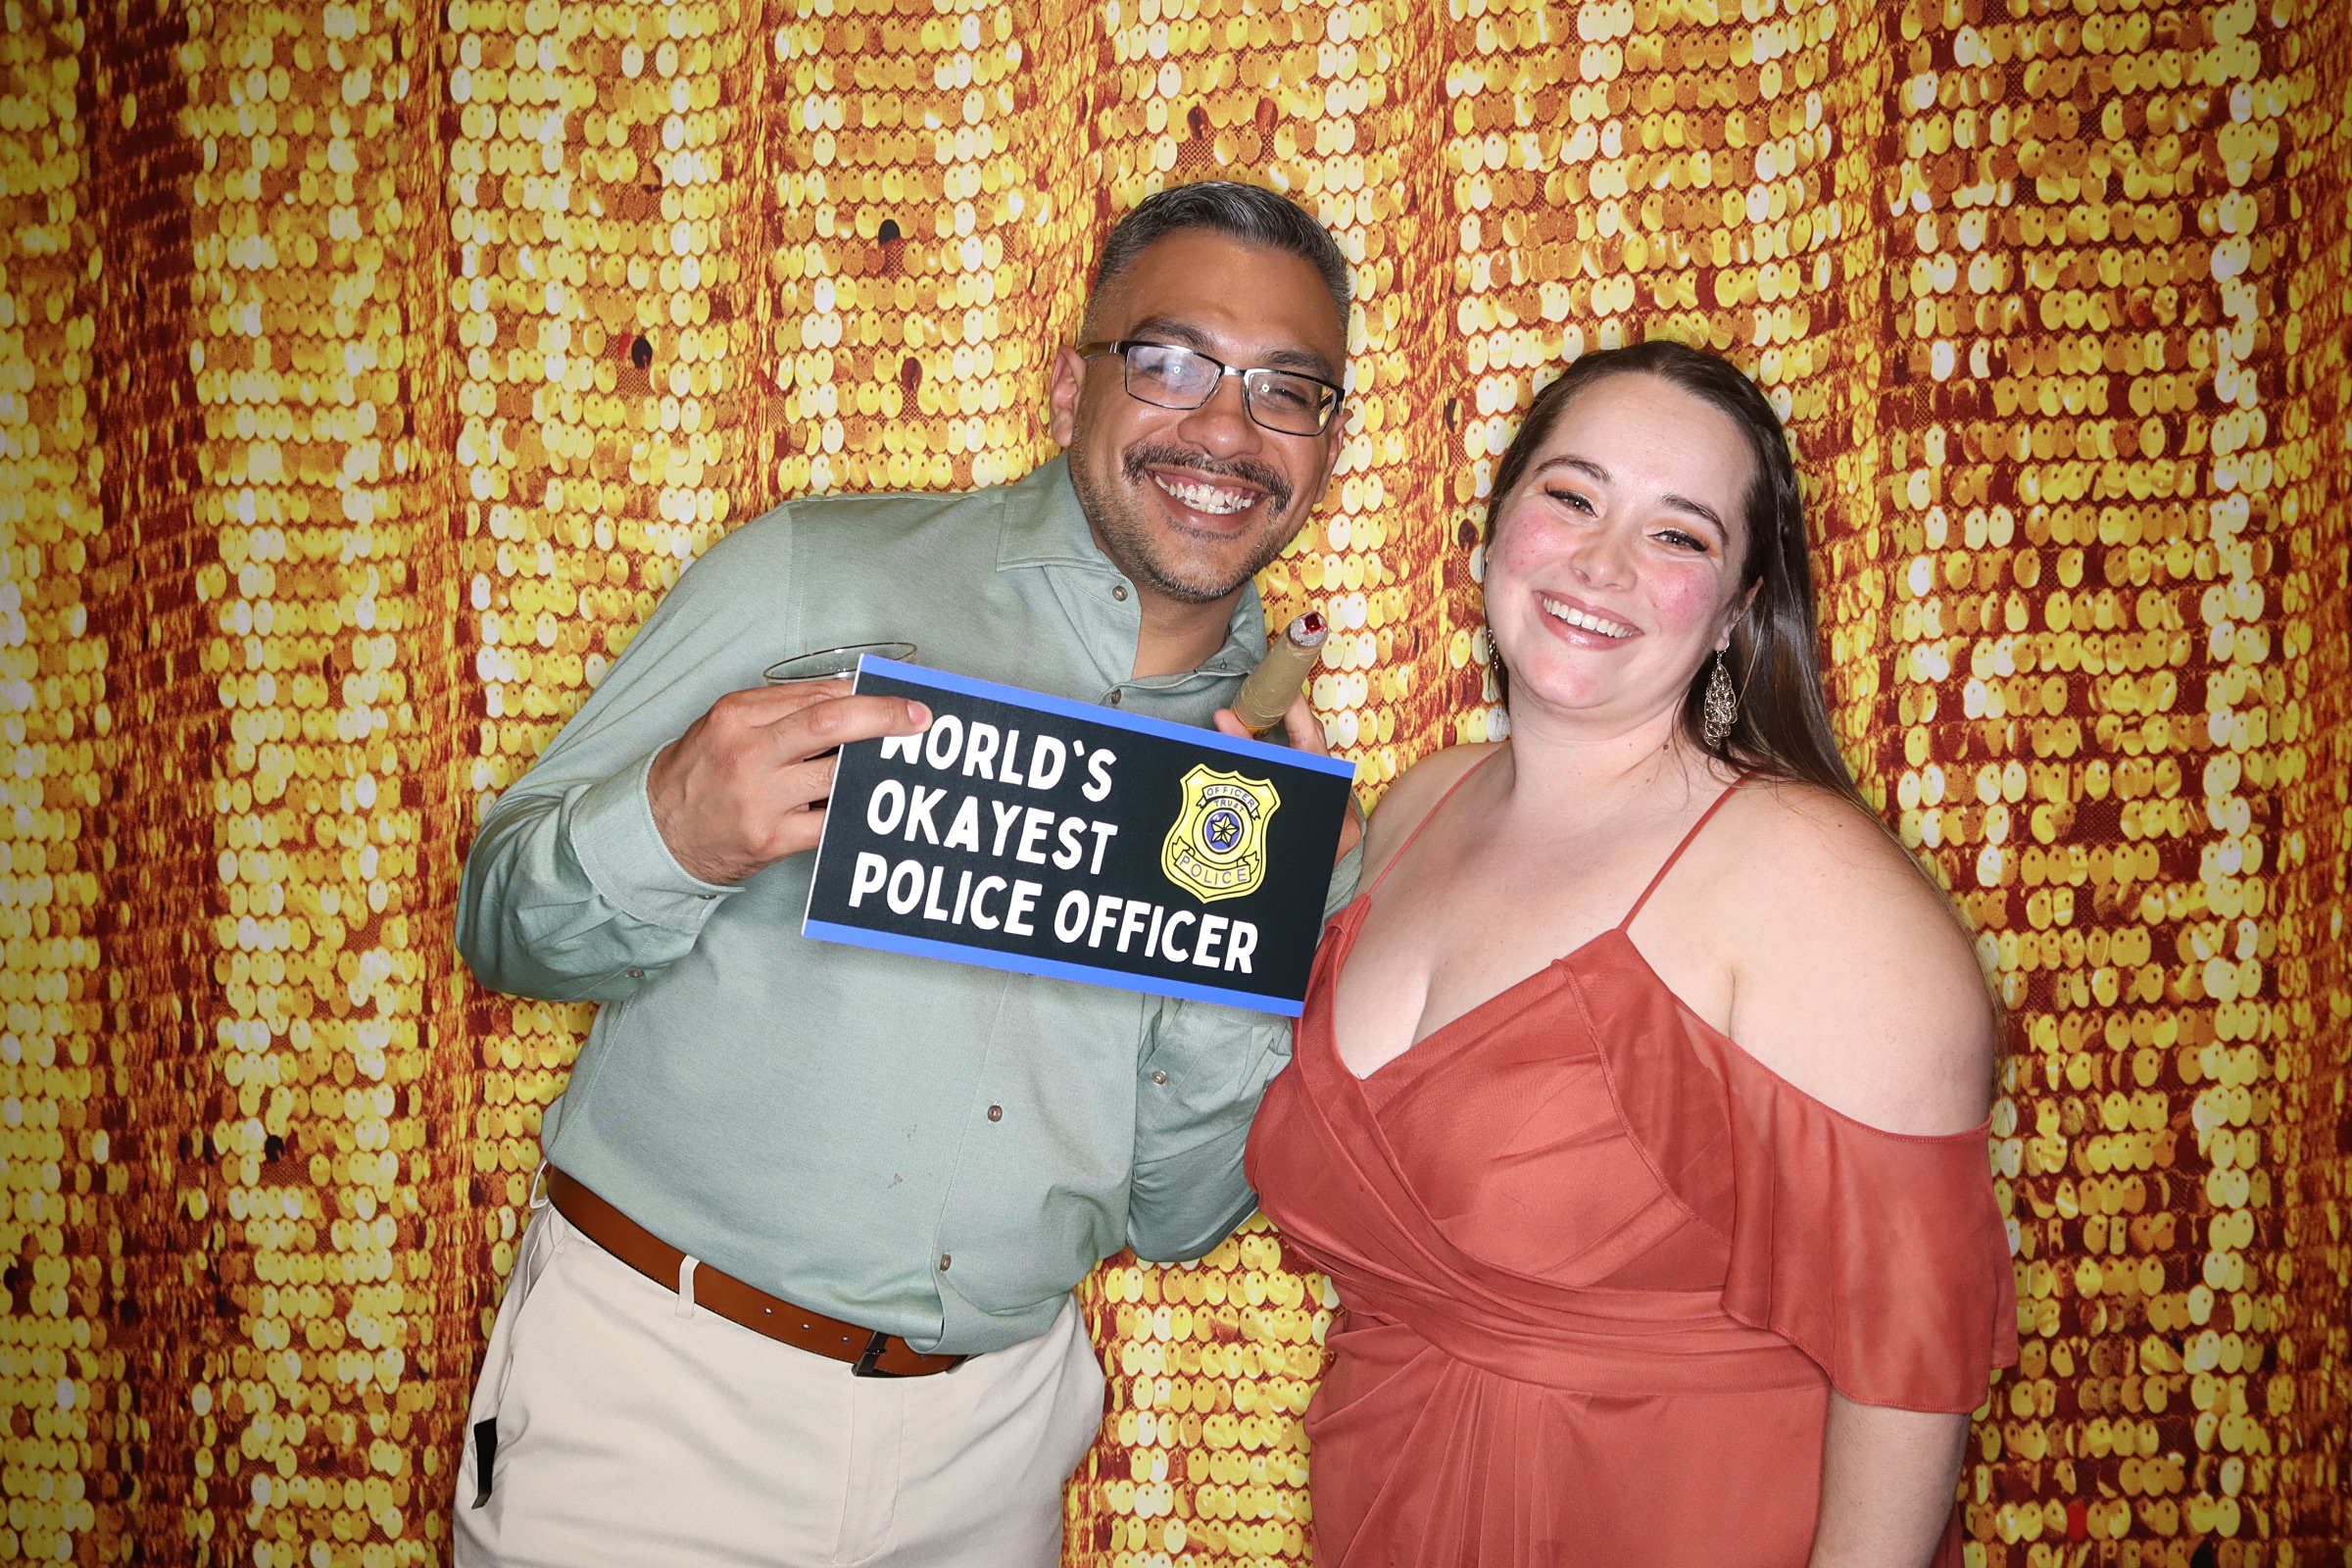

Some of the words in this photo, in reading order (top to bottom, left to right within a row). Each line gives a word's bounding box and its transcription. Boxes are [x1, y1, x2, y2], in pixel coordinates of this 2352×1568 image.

[1206, 787, 1255, 808] OFFICER
[1214, 799, 1245, 812] TRUST
[866, 779, 1119, 875] OKAYEST
[1179, 856, 1248, 885] POLICE
[848, 851, 1043, 937] POLICE
[1054, 889, 1258, 974] OFFICER
